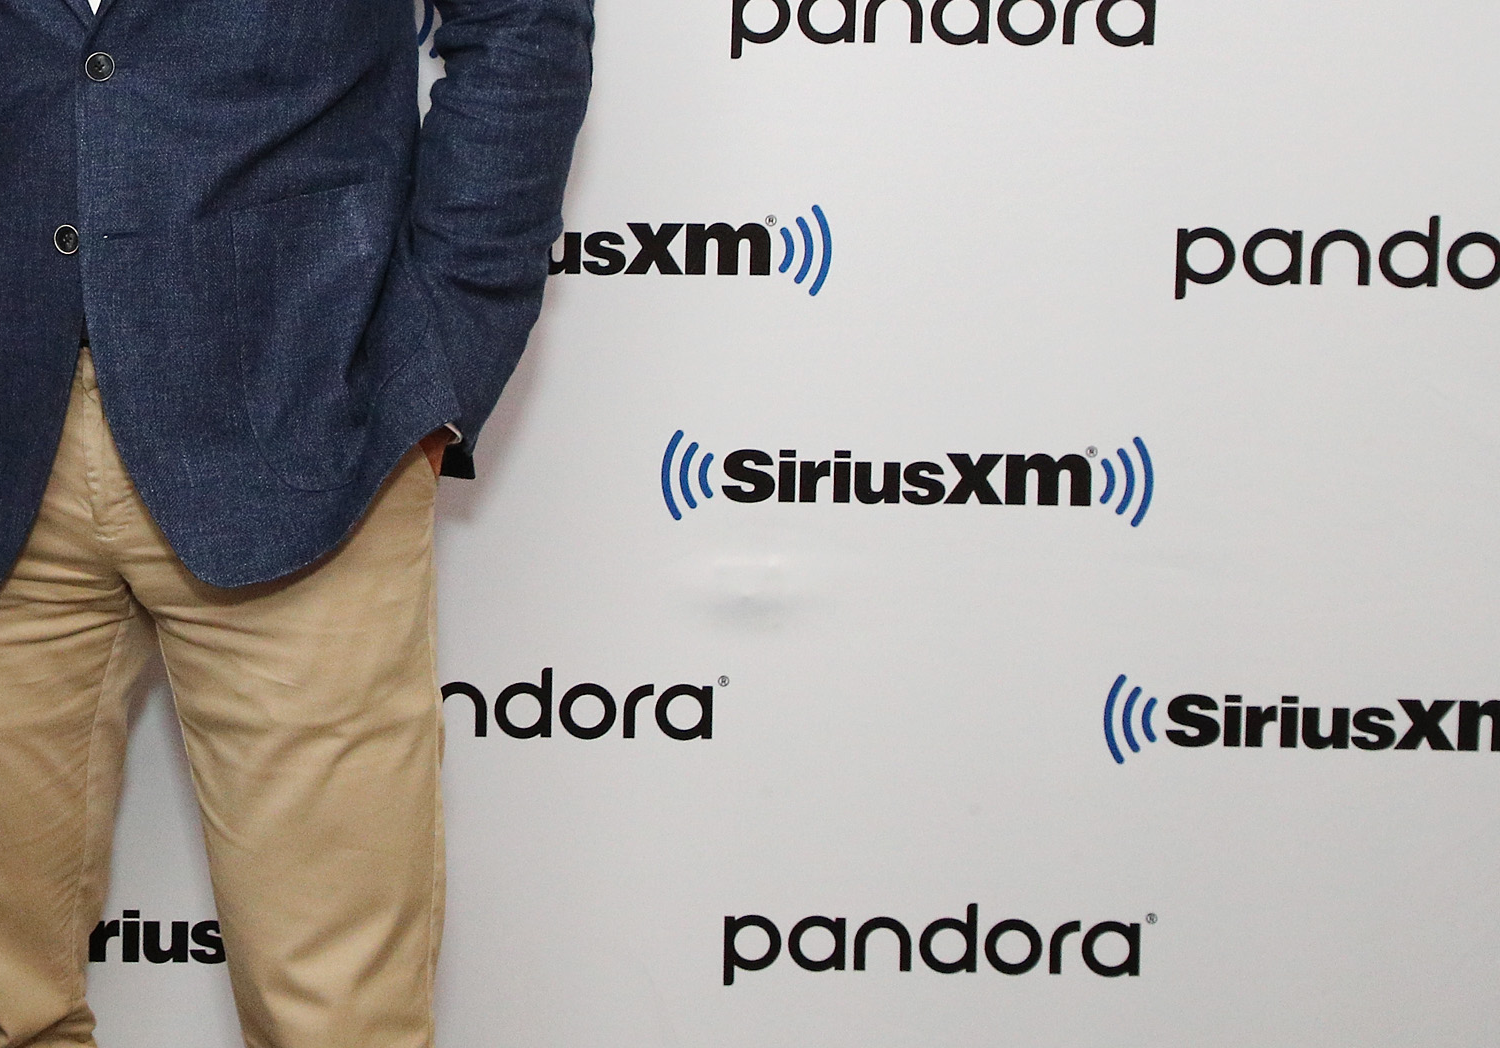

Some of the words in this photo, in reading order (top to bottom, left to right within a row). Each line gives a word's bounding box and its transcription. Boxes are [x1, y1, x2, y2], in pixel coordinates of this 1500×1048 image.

[1175, 216, 1500, 299] pando
[441, 668, 713, 741] ndora
[89, 910, 226, 964] rius
[723, 903, 1140, 986] pandora
